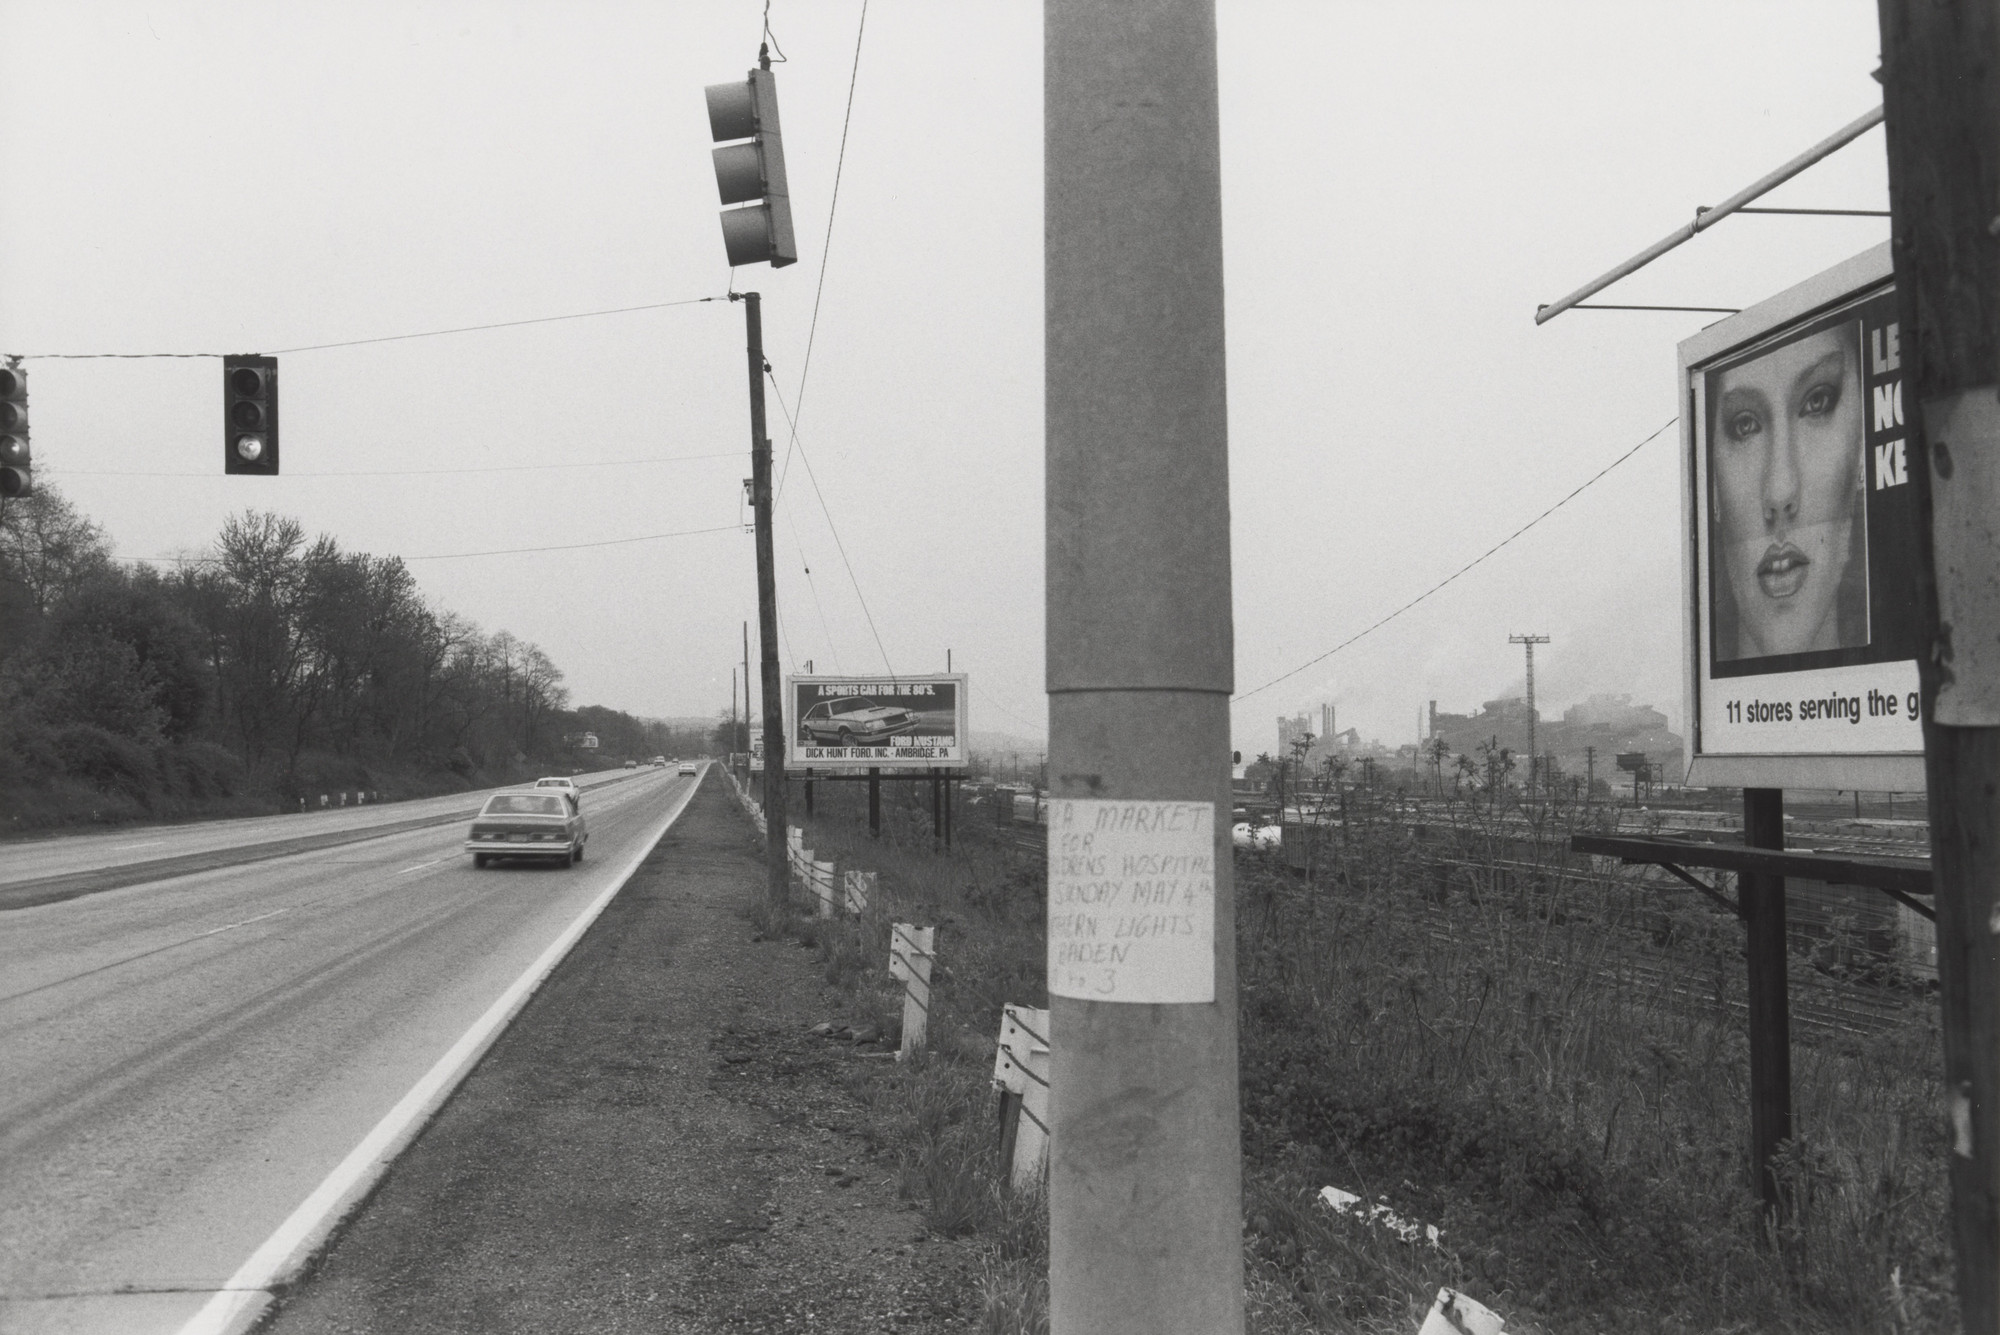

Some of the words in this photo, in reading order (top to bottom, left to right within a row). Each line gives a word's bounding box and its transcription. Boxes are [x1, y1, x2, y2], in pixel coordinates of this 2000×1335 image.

[818, 685, 825, 696] A
[825, 685, 859, 696] SPORTS
[860, 685, 877, 696] CAR
[878, 685, 895, 696] FOR
[896, 685, 911, 695] THE
[1726, 700, 1742, 724] 11
[1747, 699, 1793, 724] stores
[1799, 691, 1860, 725] serving
[1868, 688, 1898, 717] the
[806, 748, 824, 759] DICK
[826, 748, 847, 759] HUNT
[939, 747, 949, 758] PA
[890, 735, 912, 746] FORD
[913, 735, 954, 746] MUSTANG
[1095, 804, 1209, 833] MARKET
[1122, 853, 1213, 877] HOSPITAL
[1131, 879, 1179, 907] MAY
[1114, 913, 1195, 939] LIGHTS
[1093, 968, 1116, 994] 3
